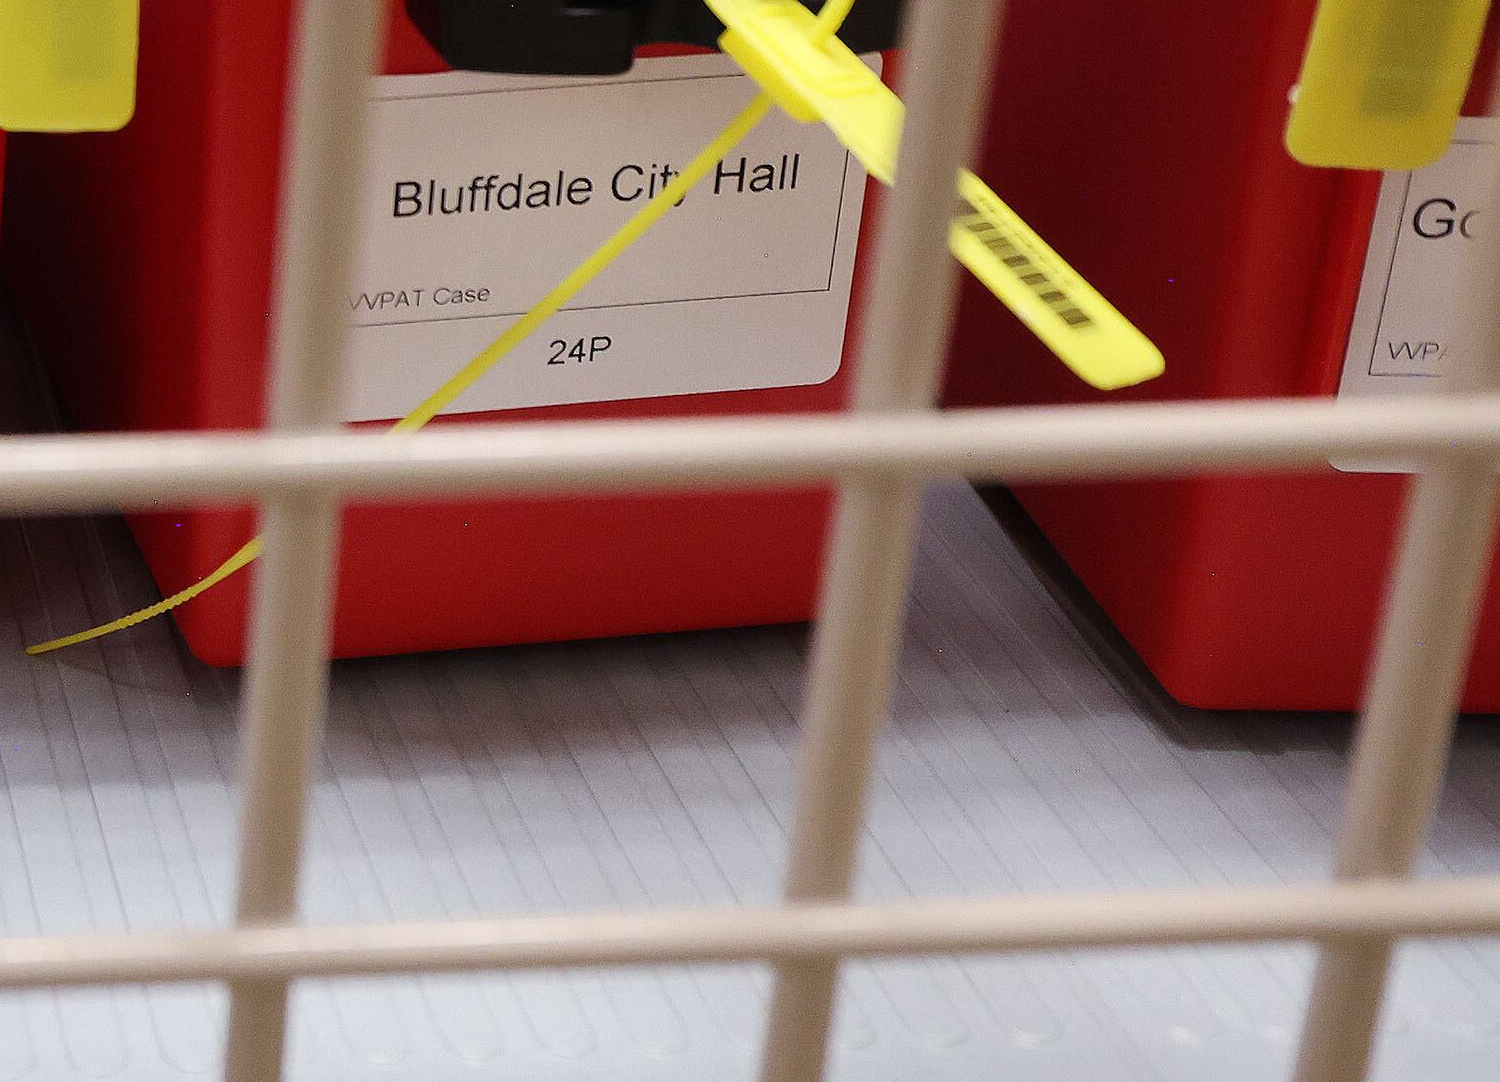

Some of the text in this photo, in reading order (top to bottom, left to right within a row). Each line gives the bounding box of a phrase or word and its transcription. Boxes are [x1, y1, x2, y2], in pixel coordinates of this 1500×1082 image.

[392, 169, 594, 218] Bluffdale
[714, 153, 800, 195] Hall
[432, 287, 491, 306] Case
[547, 335, 612, 366] 24P
